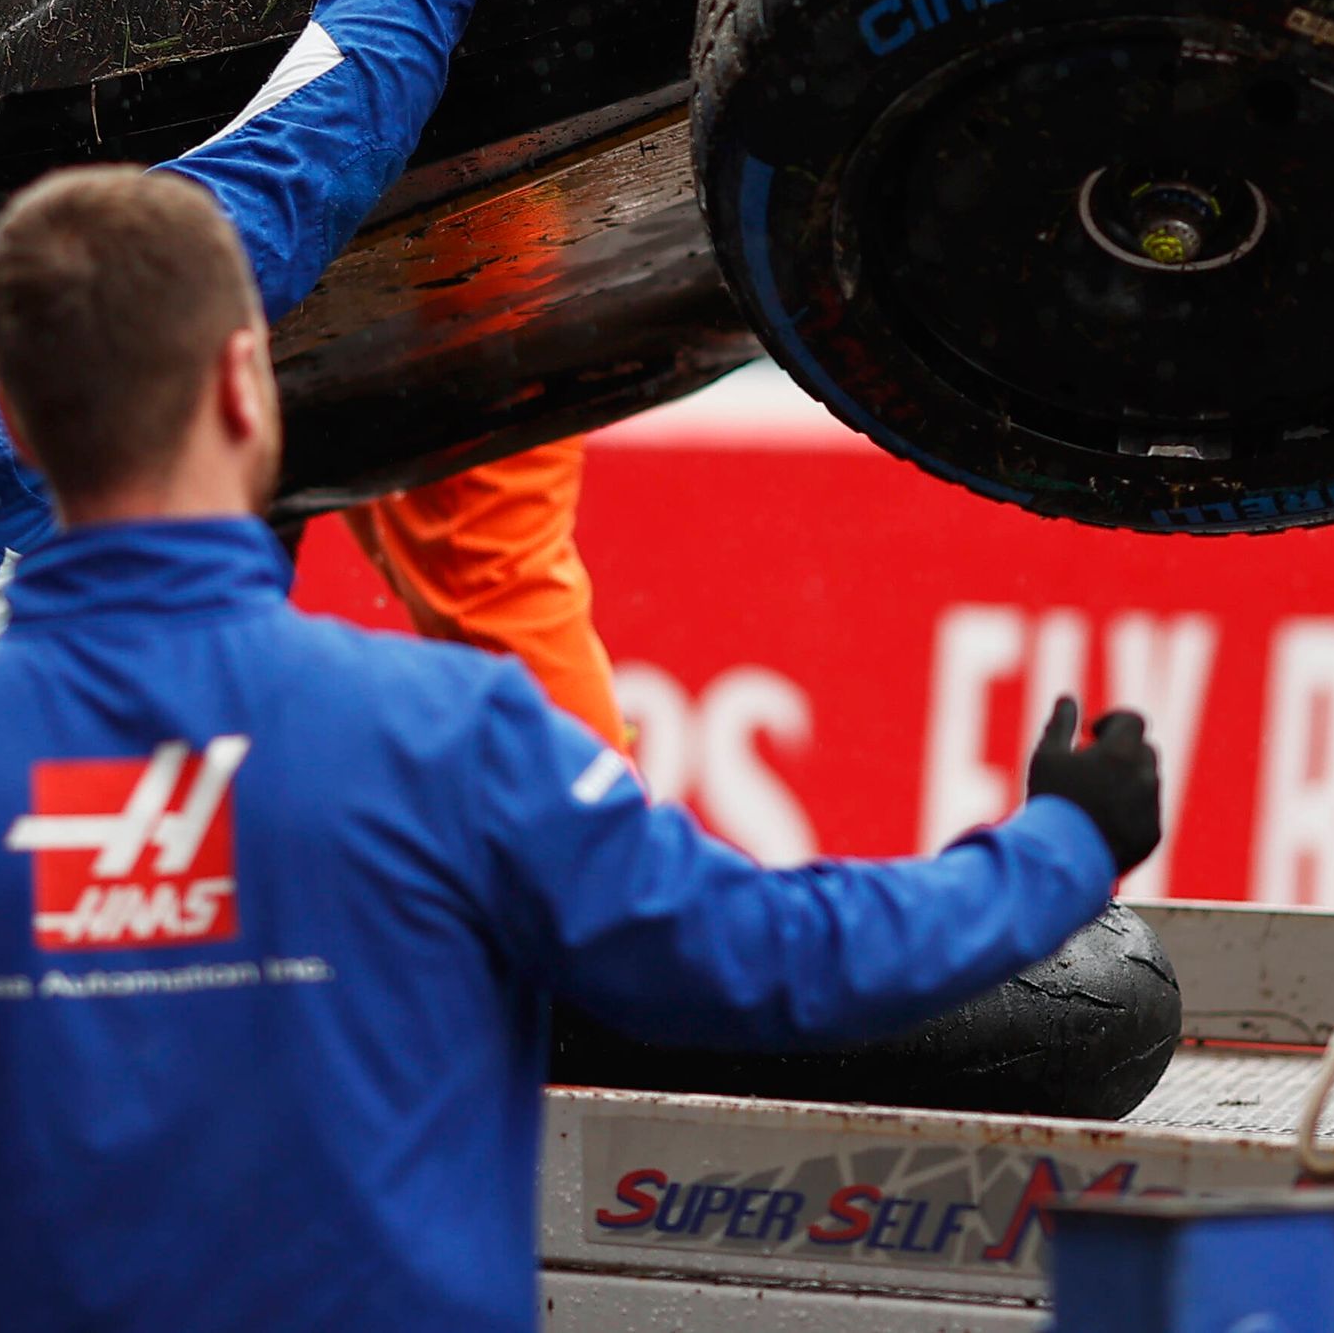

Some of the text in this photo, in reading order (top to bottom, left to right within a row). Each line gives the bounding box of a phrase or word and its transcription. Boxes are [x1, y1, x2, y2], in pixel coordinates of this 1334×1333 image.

[33, 876, 237, 943] HAAS
[596, 1168, 805, 1243] SUPER
[805, 1183, 978, 1255] SELF
